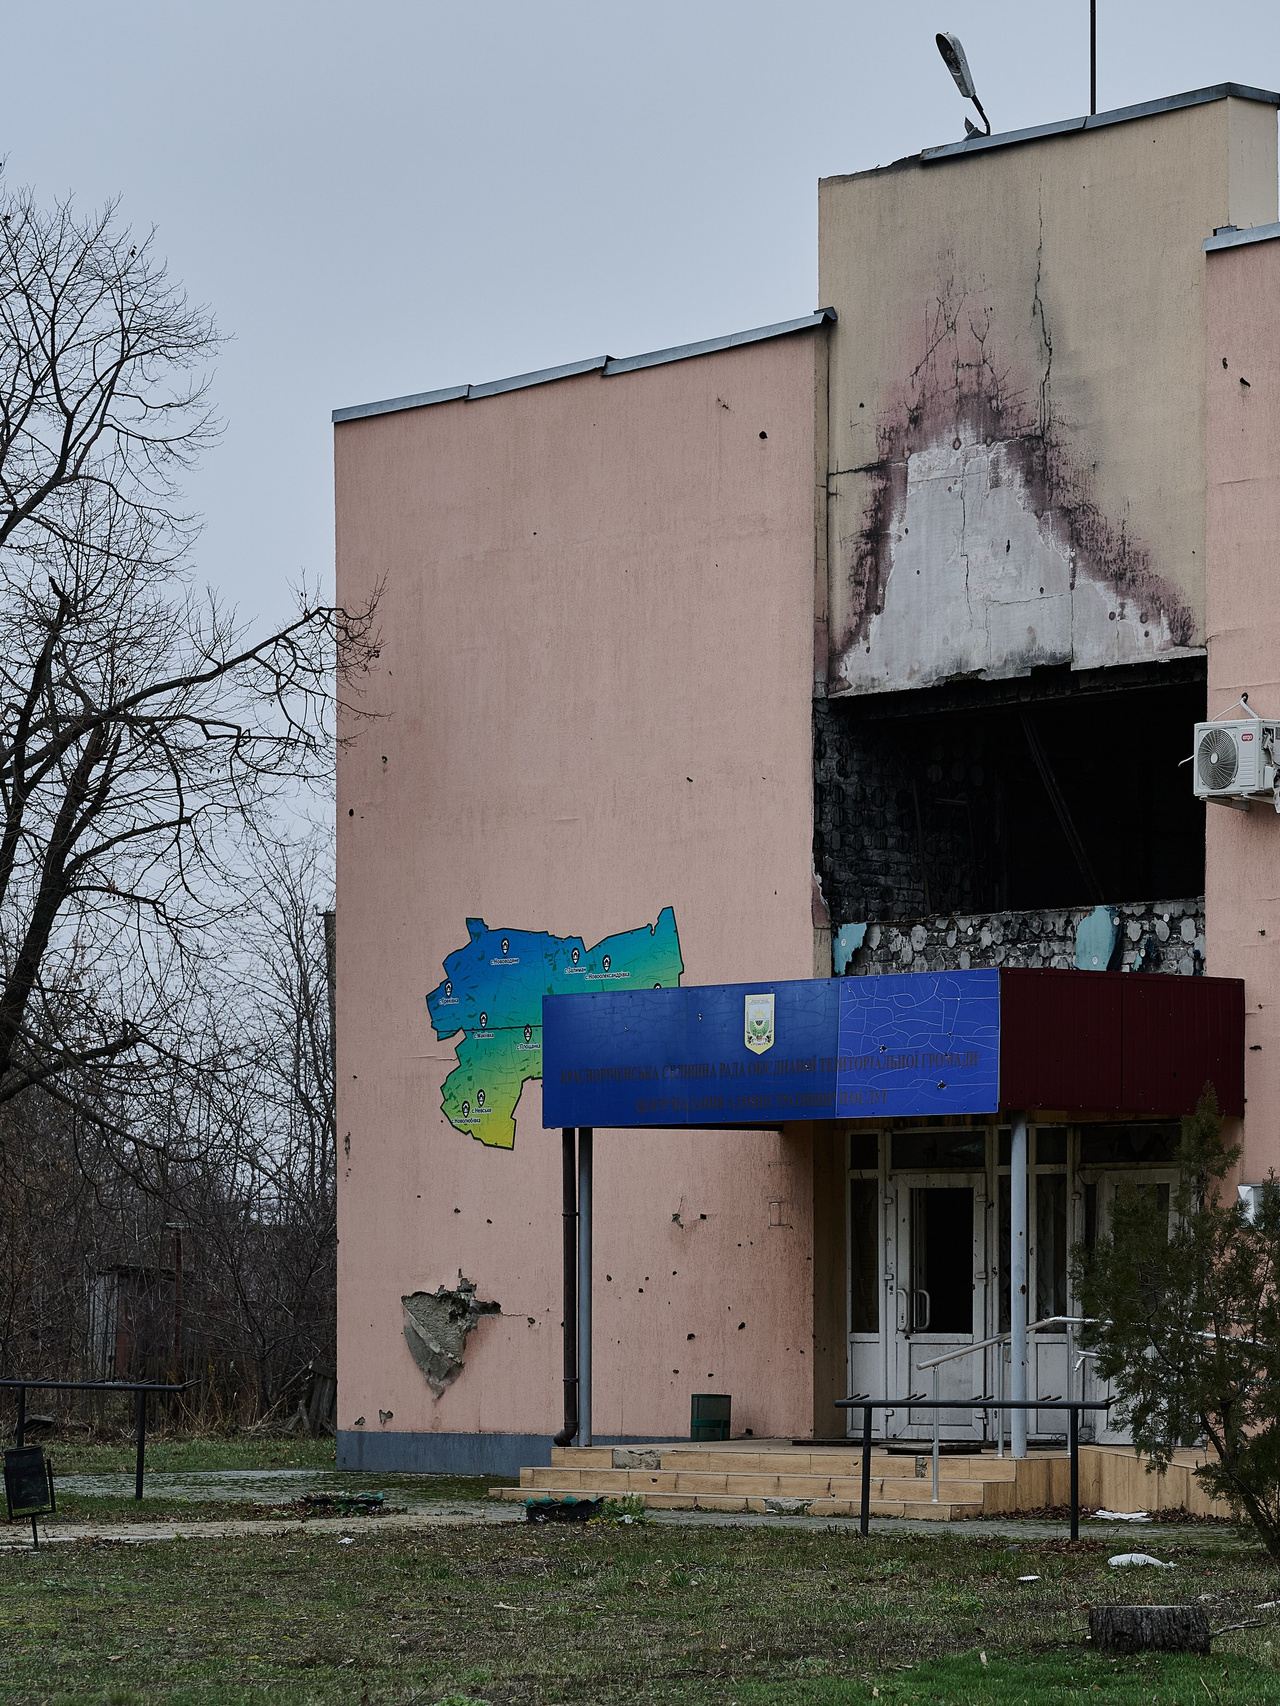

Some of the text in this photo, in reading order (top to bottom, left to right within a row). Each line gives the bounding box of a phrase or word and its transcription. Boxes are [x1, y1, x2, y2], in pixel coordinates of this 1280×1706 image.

[560, 1065, 659, 1084] КРАСНОРІЧЕНСЬКА
[661, 1062, 717, 1080] СЕЛИЩНА
[719, 1060, 746, 1078] РАДА
[921, 1050, 979, 1069] ГРОМАДИ
[635, 1097, 670, 1115] ЦЕНТР
[727, 1091, 837, 1111] АДМІНІСТРАТИВНИ
[839, 1089, 890, 1106] ПОСЛУГ
